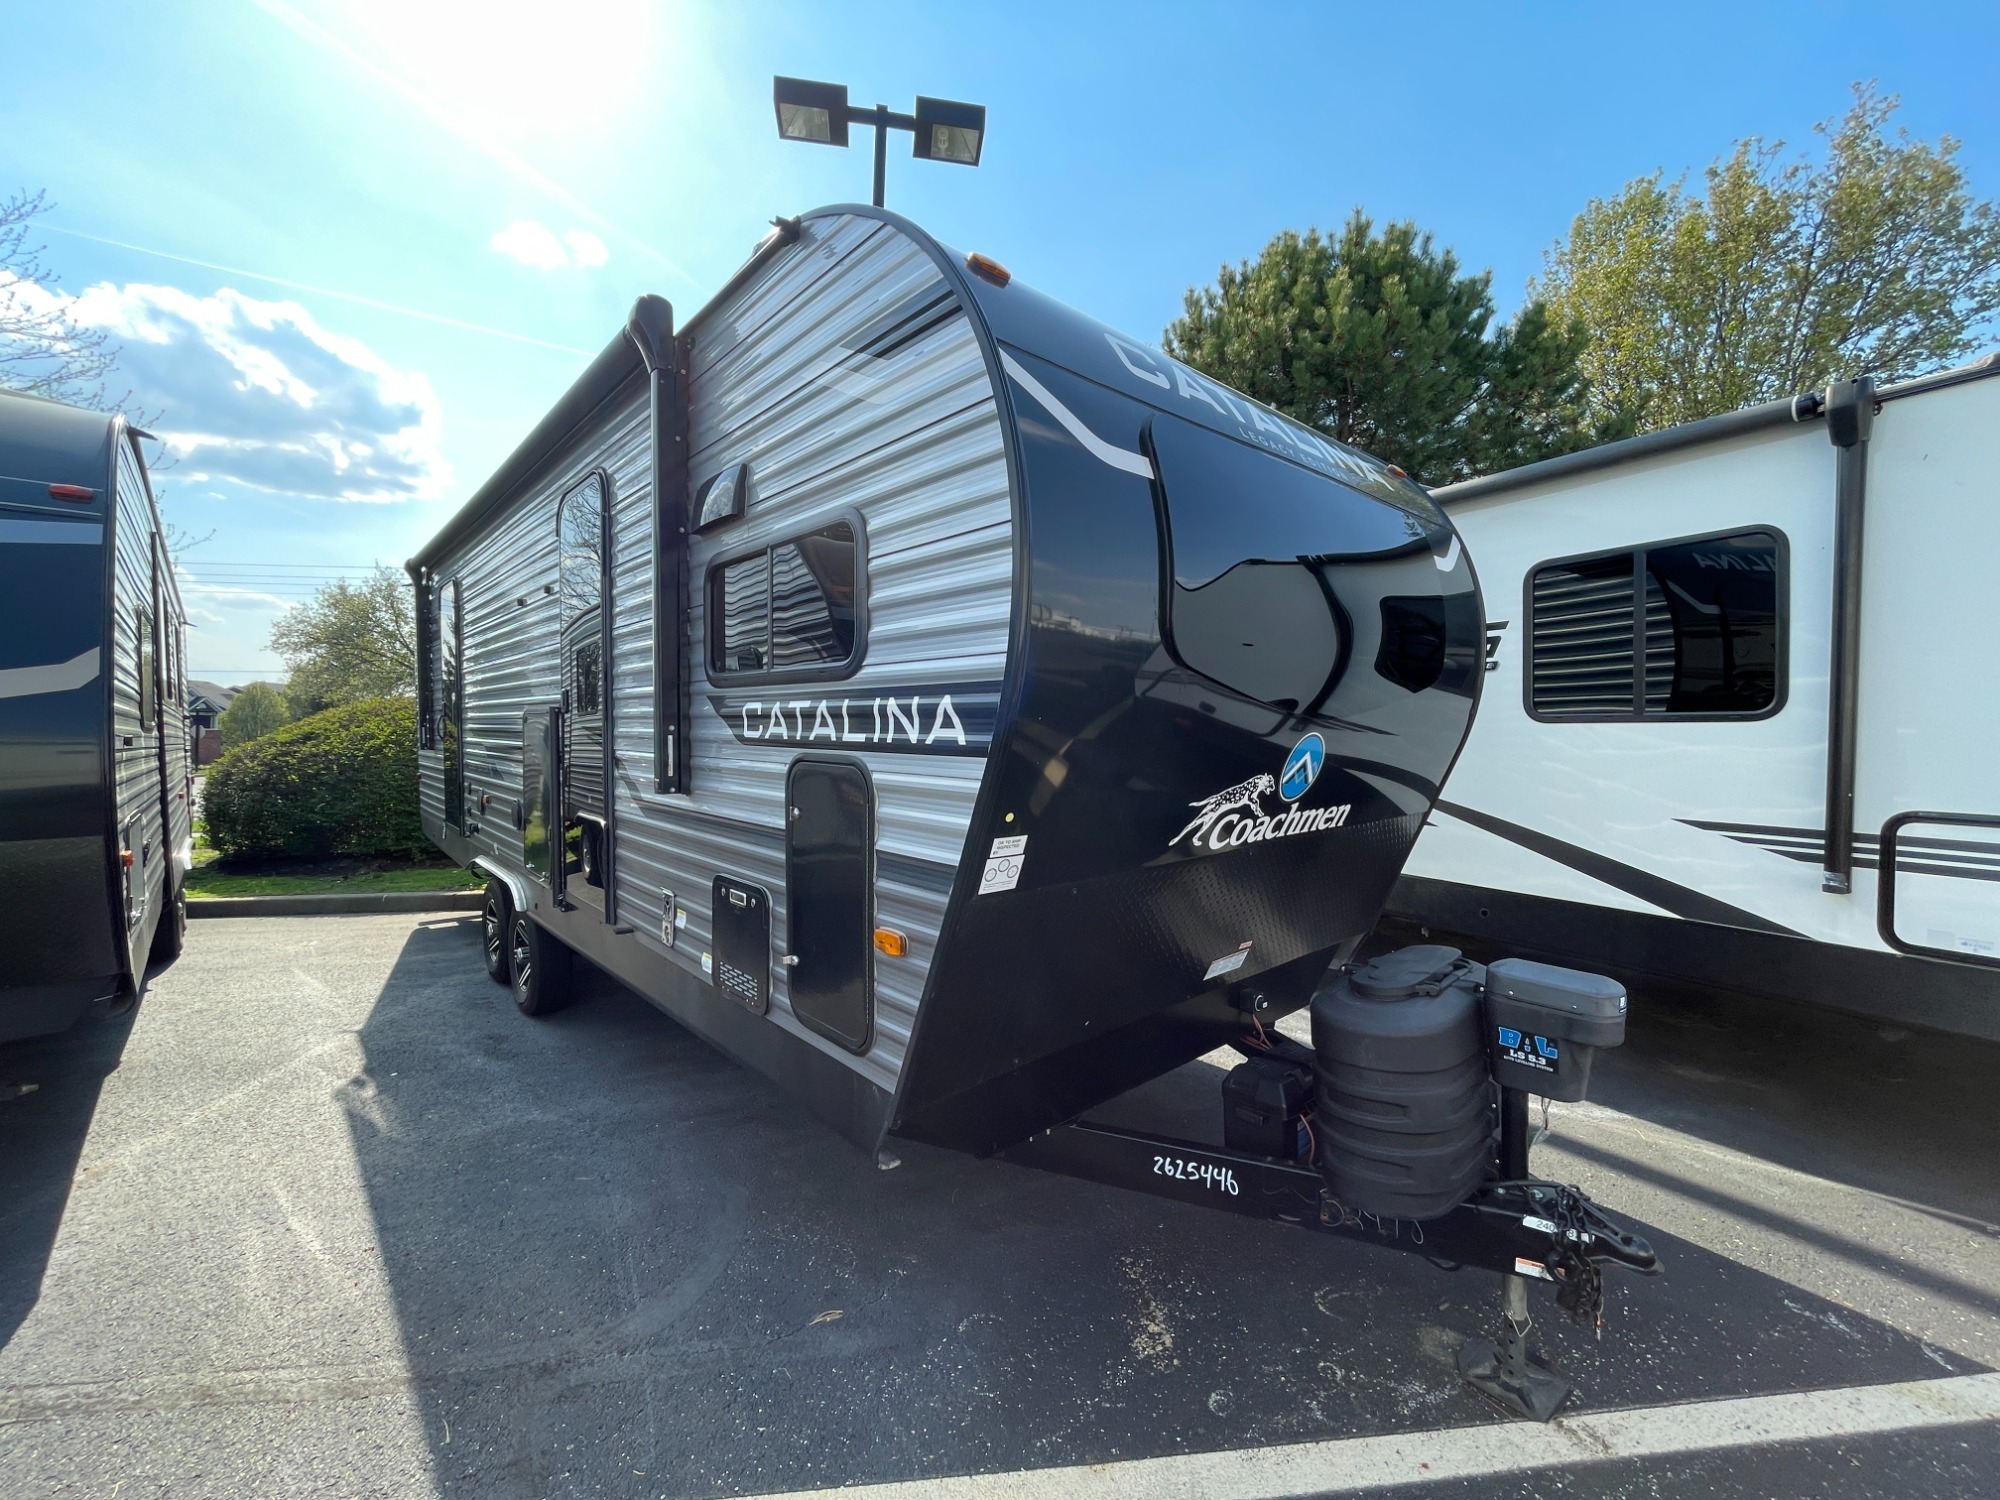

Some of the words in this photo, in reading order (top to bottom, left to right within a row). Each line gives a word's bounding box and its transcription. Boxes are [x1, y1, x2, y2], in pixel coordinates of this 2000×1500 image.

[1103, 332, 1395, 492] CATALINA
[1238, 426, 1296, 458] LEGACY
[1299, 453, 1349, 481] EDITION
[742, 694, 967, 746] CATALINA
[1208, 802, 1351, 850] Coachmen
[1153, 1156, 1239, 1196] 2625446
